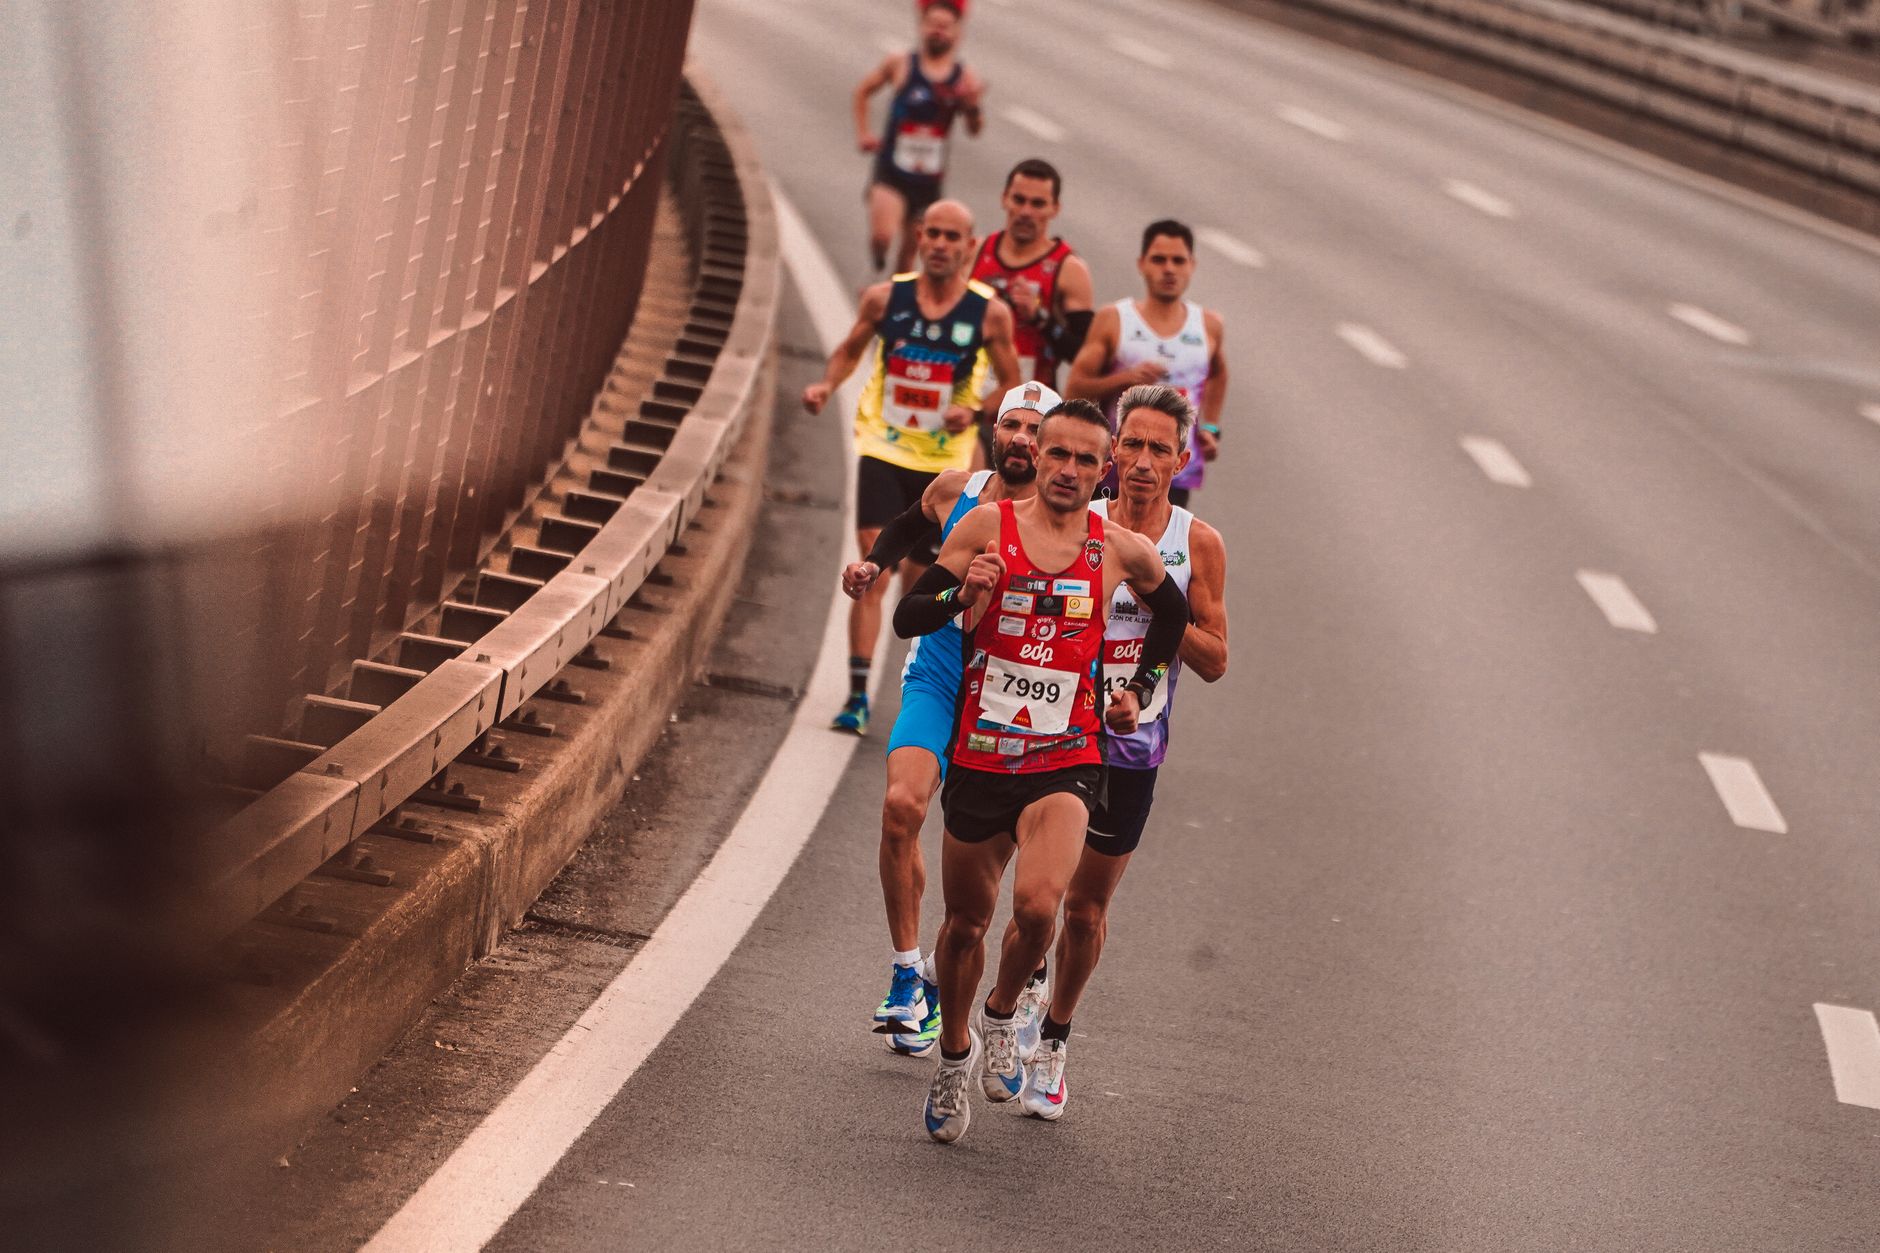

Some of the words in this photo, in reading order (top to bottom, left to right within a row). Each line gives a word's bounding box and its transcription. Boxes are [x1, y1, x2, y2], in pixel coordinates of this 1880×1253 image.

[1108, 614, 1124, 622] CIÓN
[1019, 641, 1054, 667] edp
[1002, 672, 1060, 703] 7999
